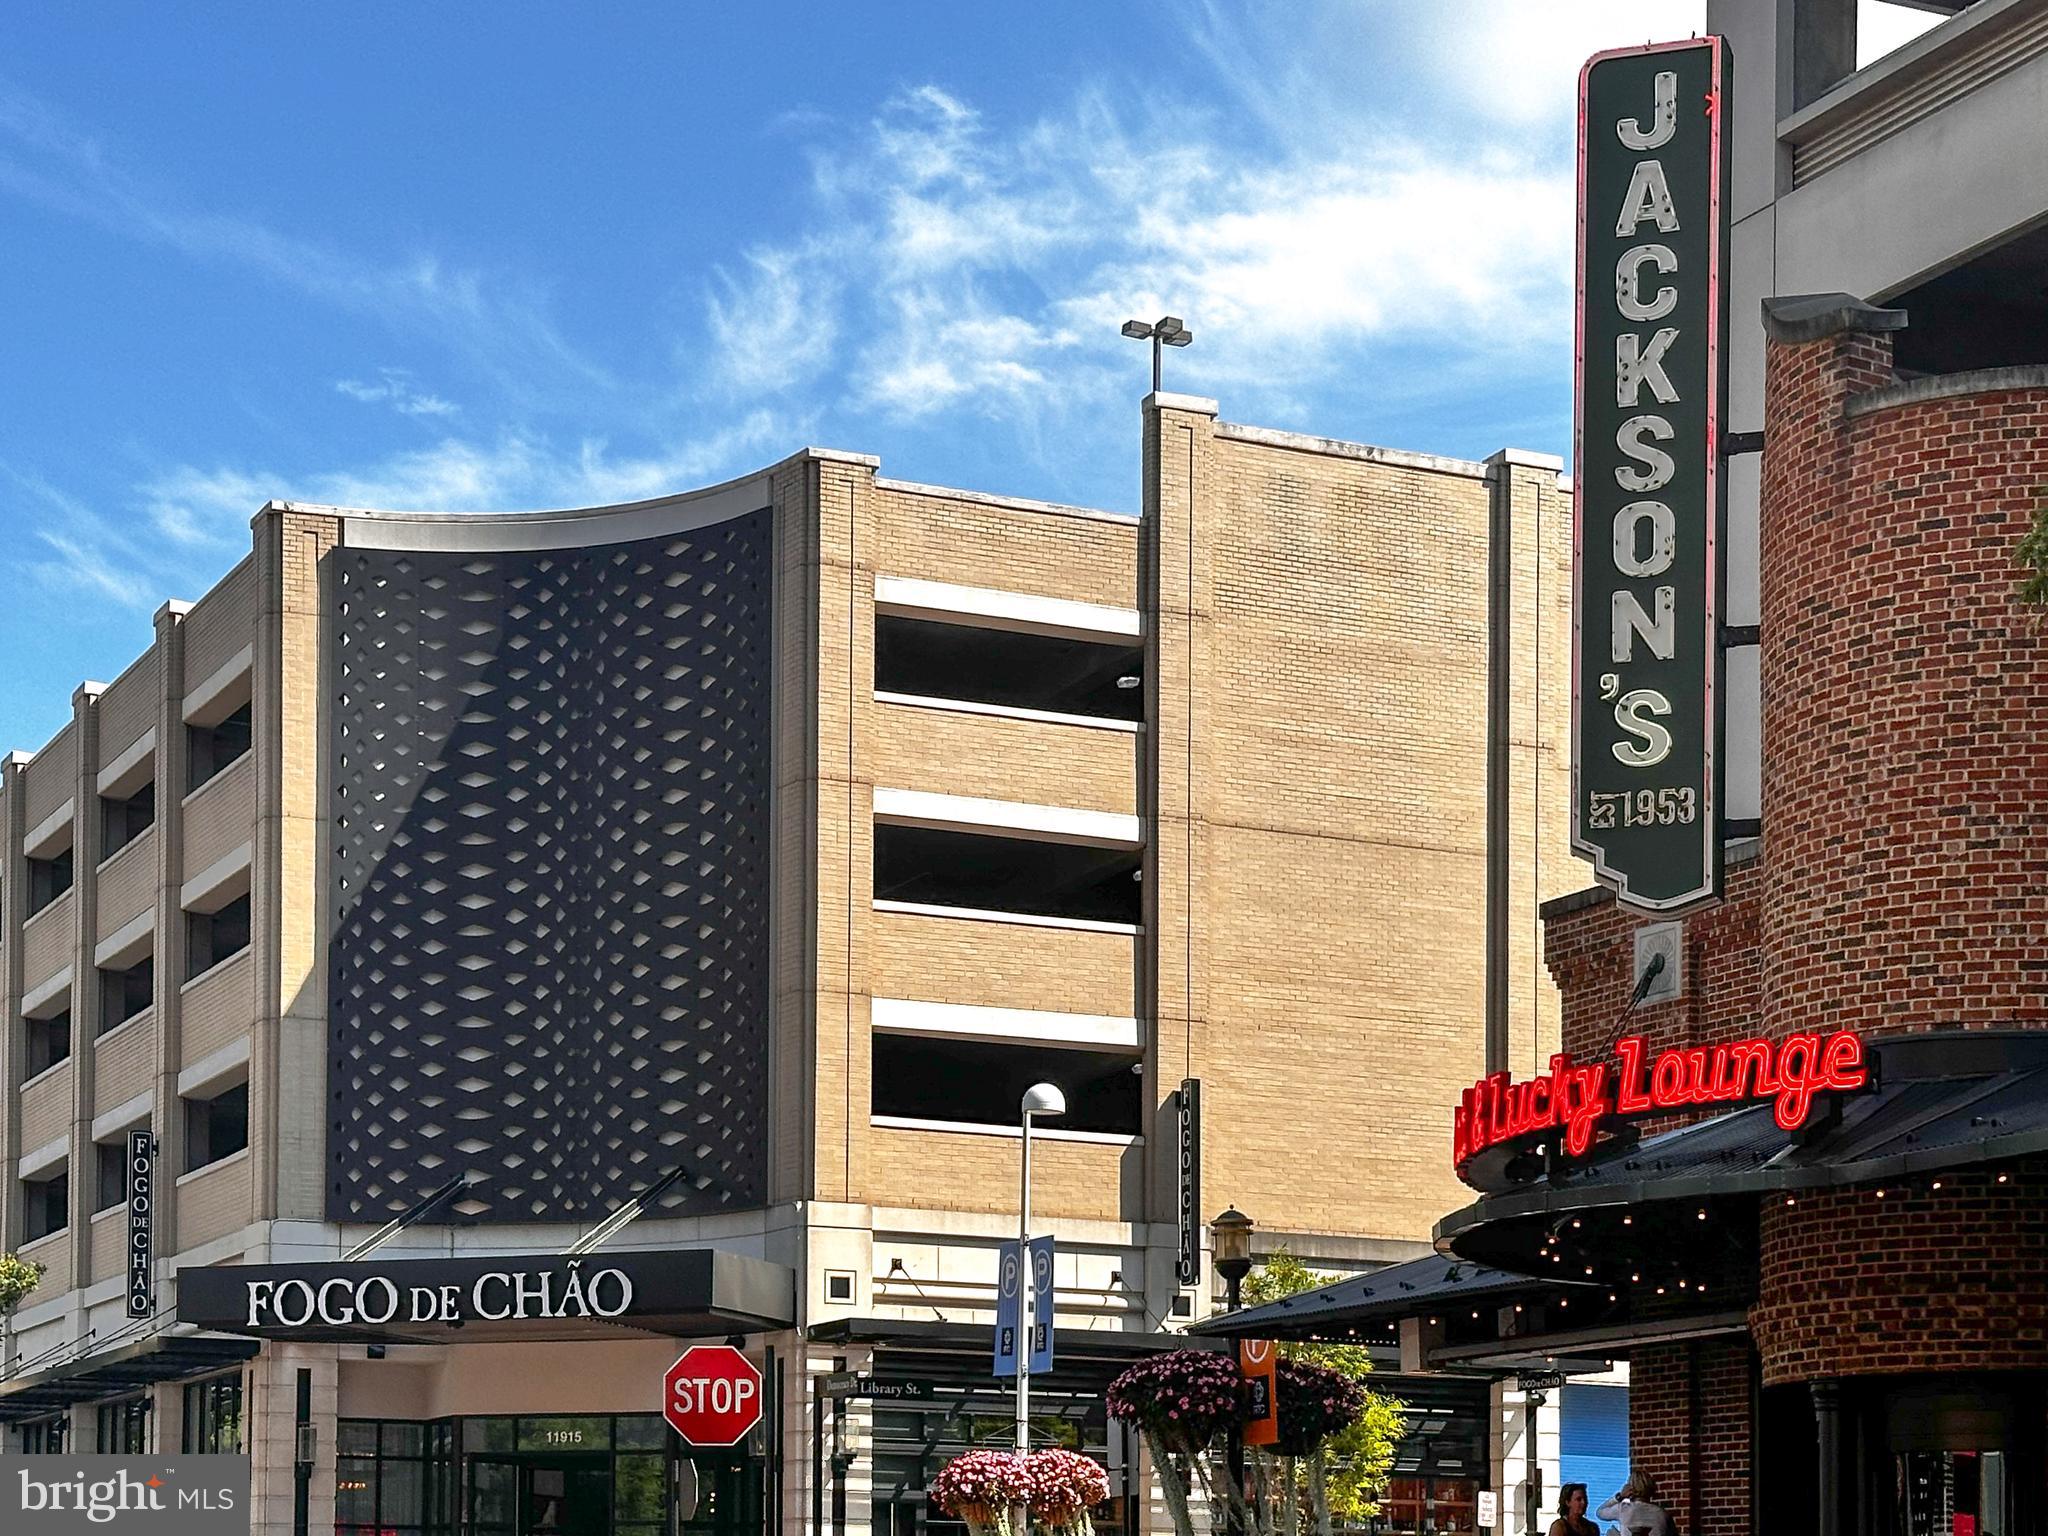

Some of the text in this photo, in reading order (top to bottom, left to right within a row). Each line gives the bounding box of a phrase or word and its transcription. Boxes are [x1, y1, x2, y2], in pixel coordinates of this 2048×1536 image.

[1600, 71, 1681, 768] JACKSON'S
[1622, 786, 1696, 828] 1953
[1181, 1087, 1191, 1168] FOGO
[1490, 1053, 1606, 1158] Lucky
[1616, 1030, 1869, 1131] Lounge
[131, 1137, 150, 1311] FOGO DE CHÃO
[246, 1259, 633, 1327] FOGO DE CHÃO
[673, 1377, 756, 1414] STOP
[860, 1381, 903, 1398] Library
[905, 1382, 921, 1395] St.
[546, 1430, 583, 1443] 11915
